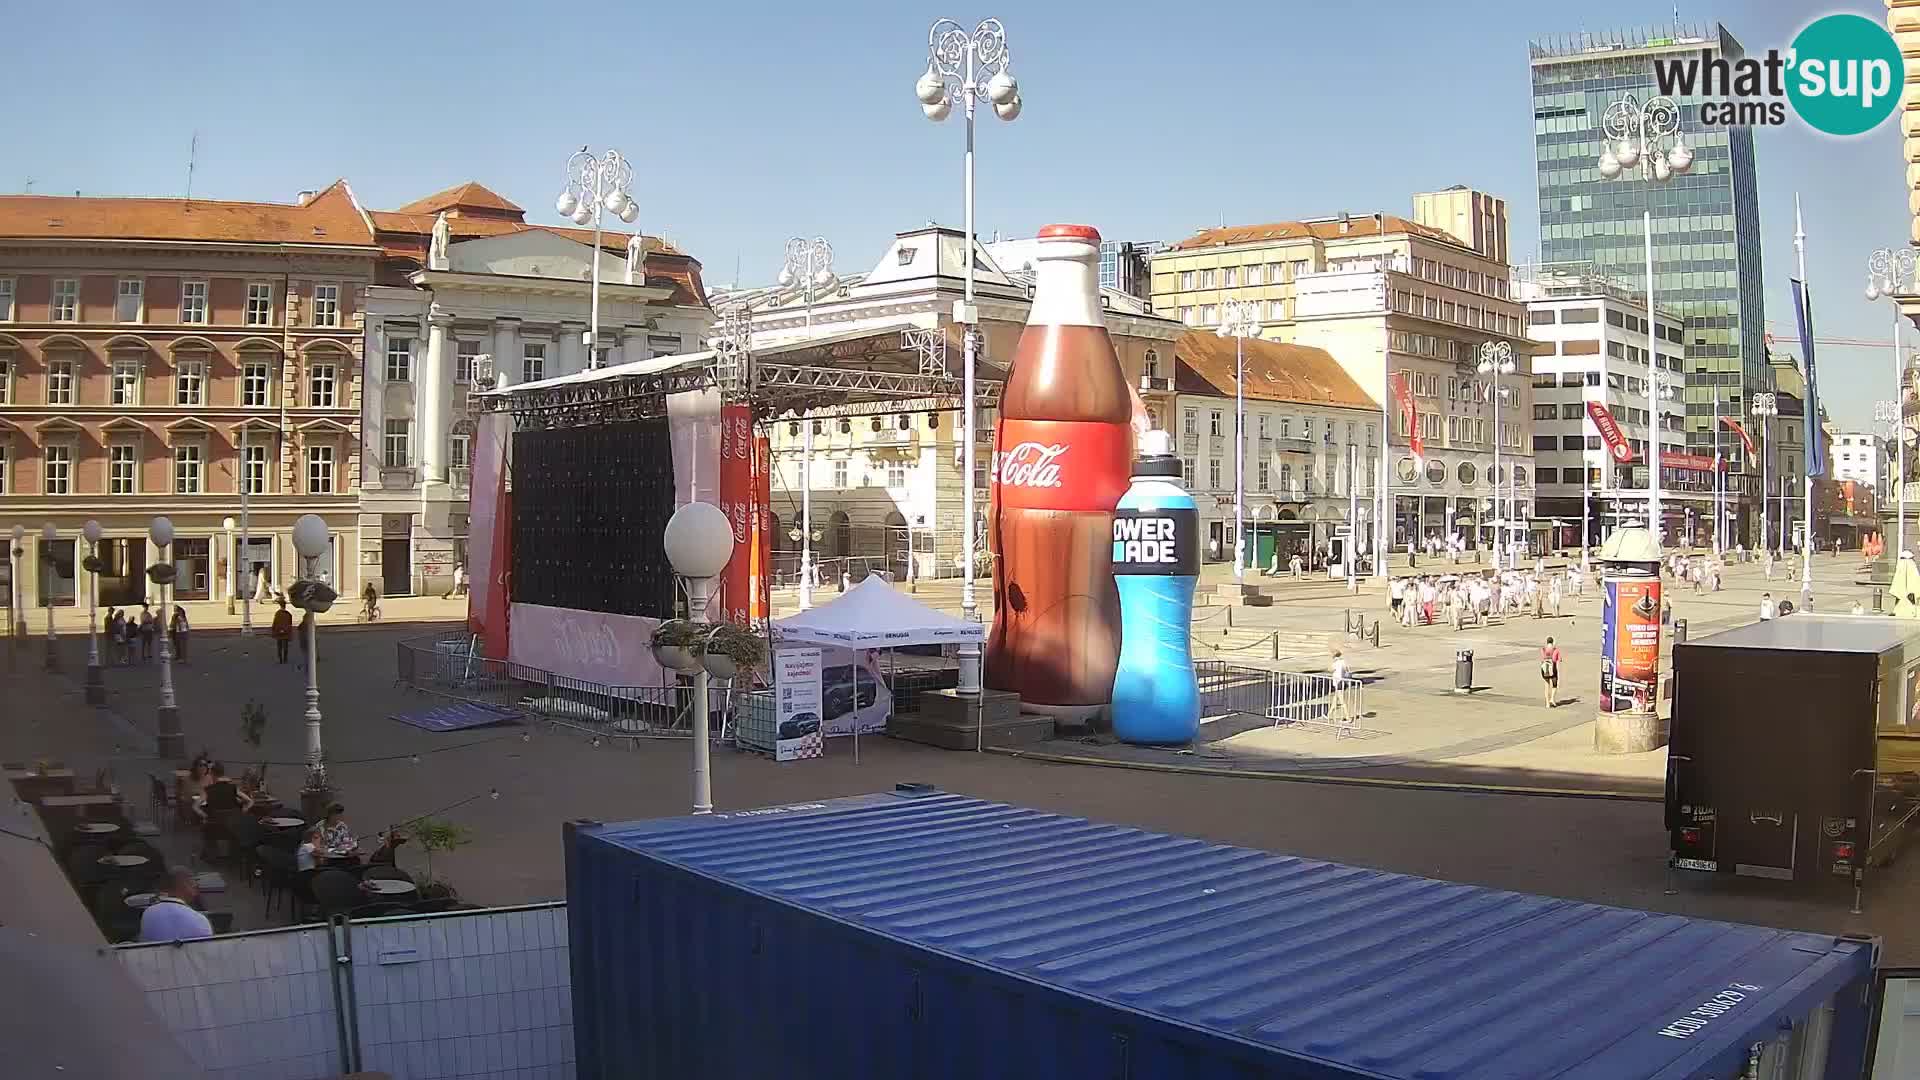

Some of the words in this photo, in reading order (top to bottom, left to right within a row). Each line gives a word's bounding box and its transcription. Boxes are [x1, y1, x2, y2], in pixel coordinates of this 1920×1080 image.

[735, 416, 749, 460] Coca-Cola
[734, 501, 747, 544] Coca-Cola
[1657, 1016, 1709, 1040] MCDU
[1690, 989, 1748, 1019] 300629
